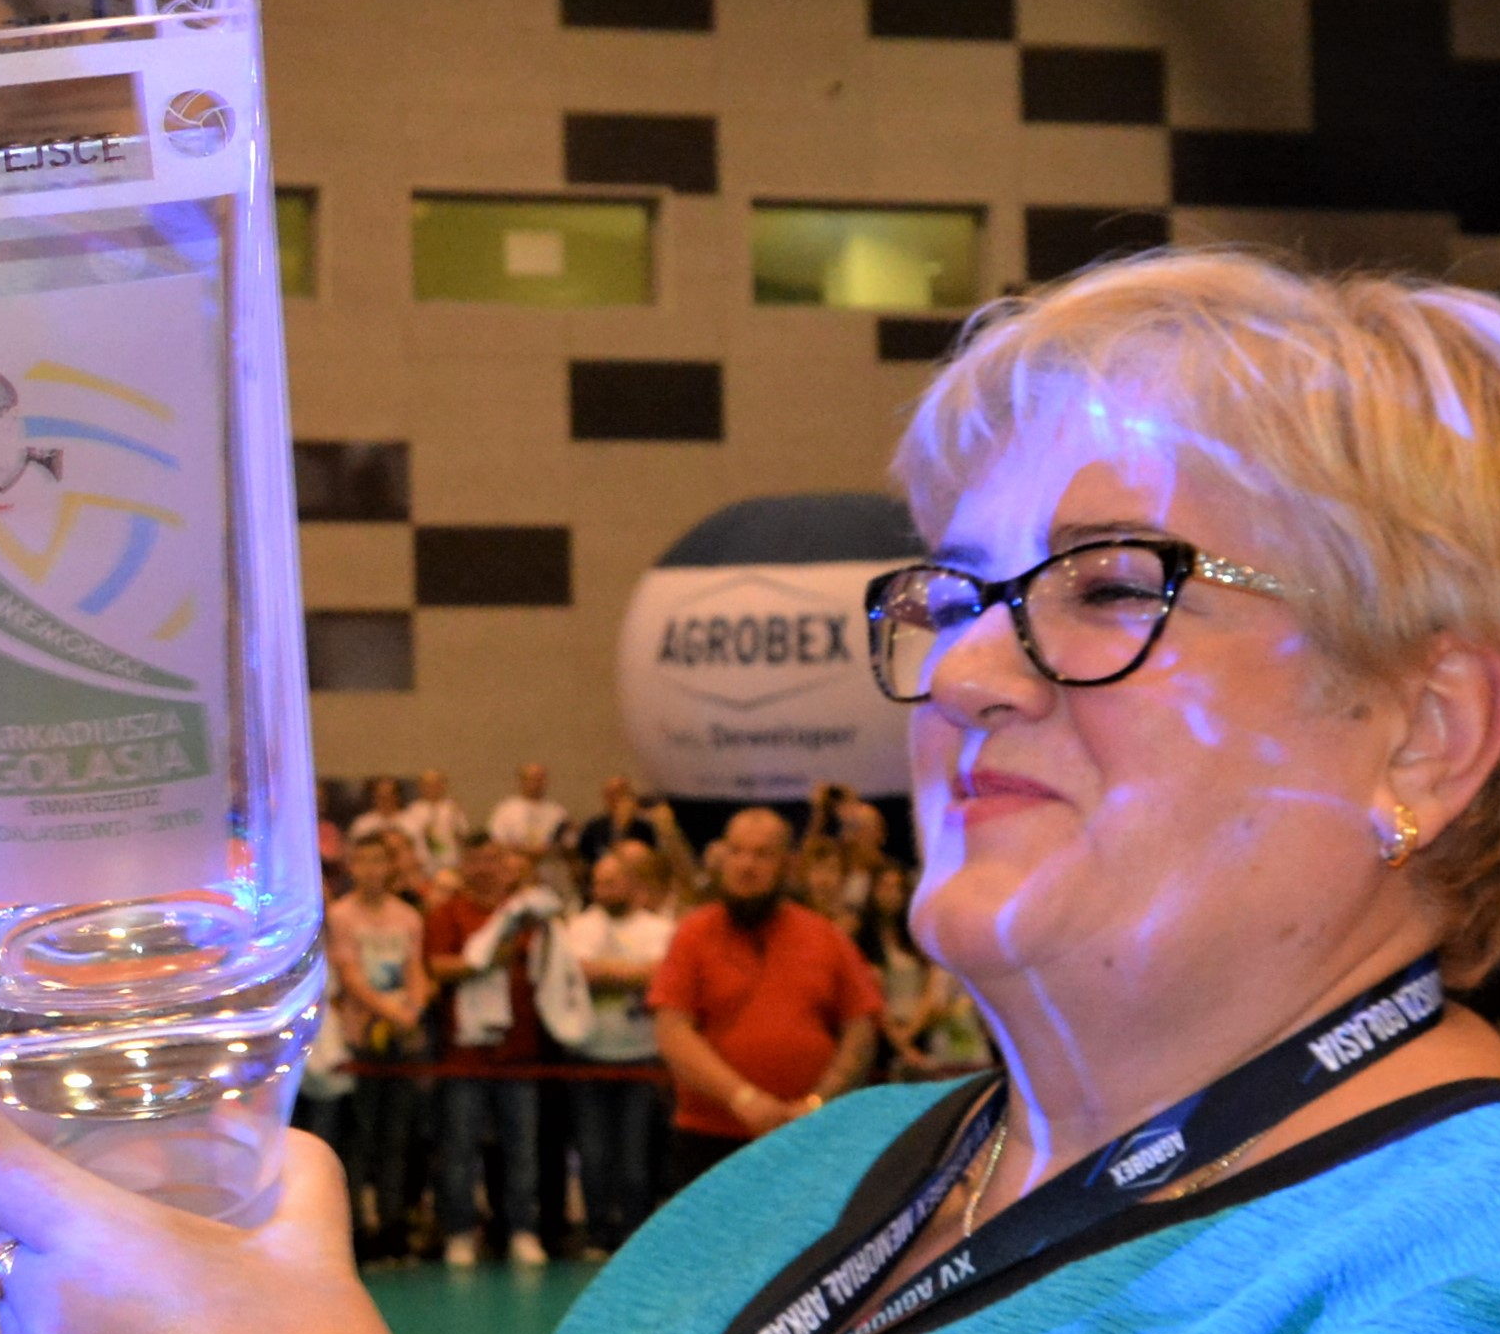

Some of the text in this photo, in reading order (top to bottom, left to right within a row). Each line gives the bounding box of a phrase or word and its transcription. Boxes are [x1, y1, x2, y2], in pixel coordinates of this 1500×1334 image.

[658, 613, 852, 666] AGROBEX
[1109, 1131, 1186, 1187] AGROBEX
[940, 1250, 977, 1290] XV
